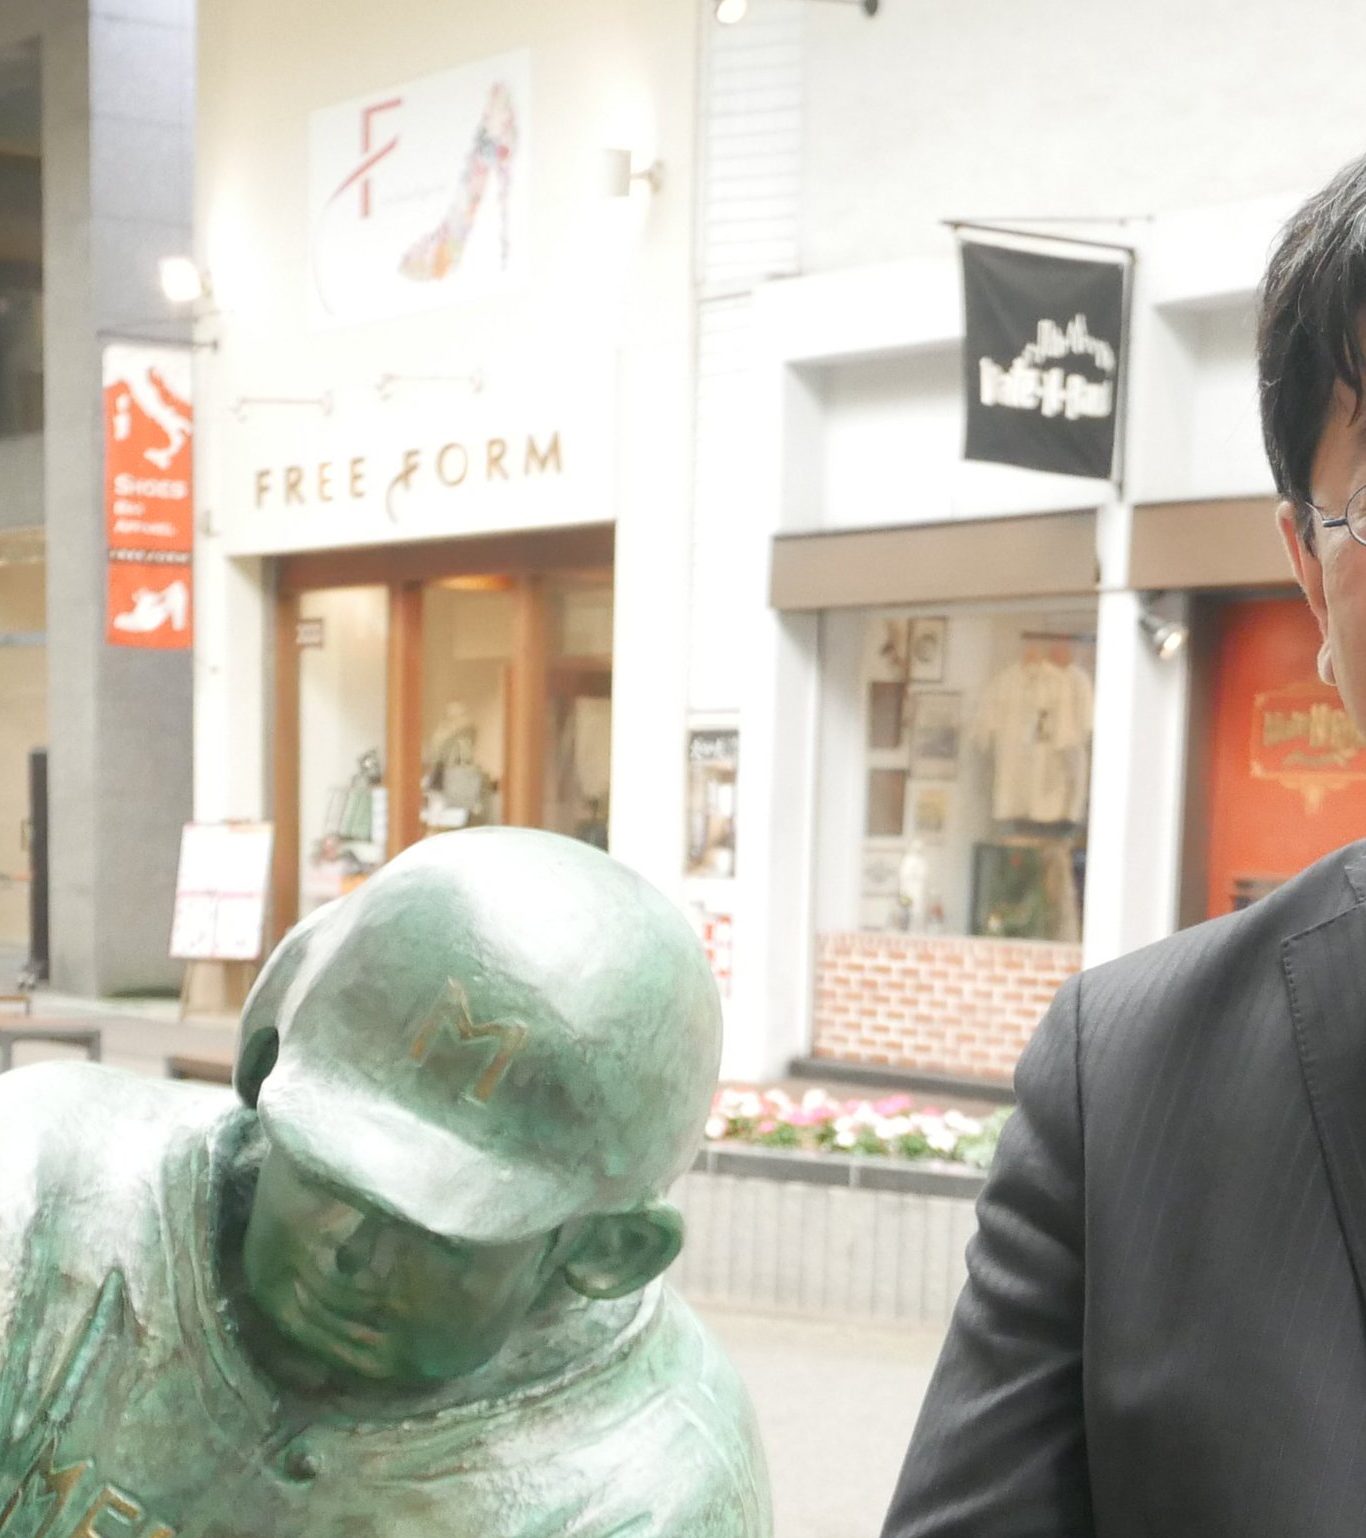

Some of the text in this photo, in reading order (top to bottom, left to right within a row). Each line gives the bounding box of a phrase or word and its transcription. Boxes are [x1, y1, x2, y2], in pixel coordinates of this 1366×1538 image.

[253, 430, 565, 525] FREE FORM
[410, 976, 528, 1104] M
